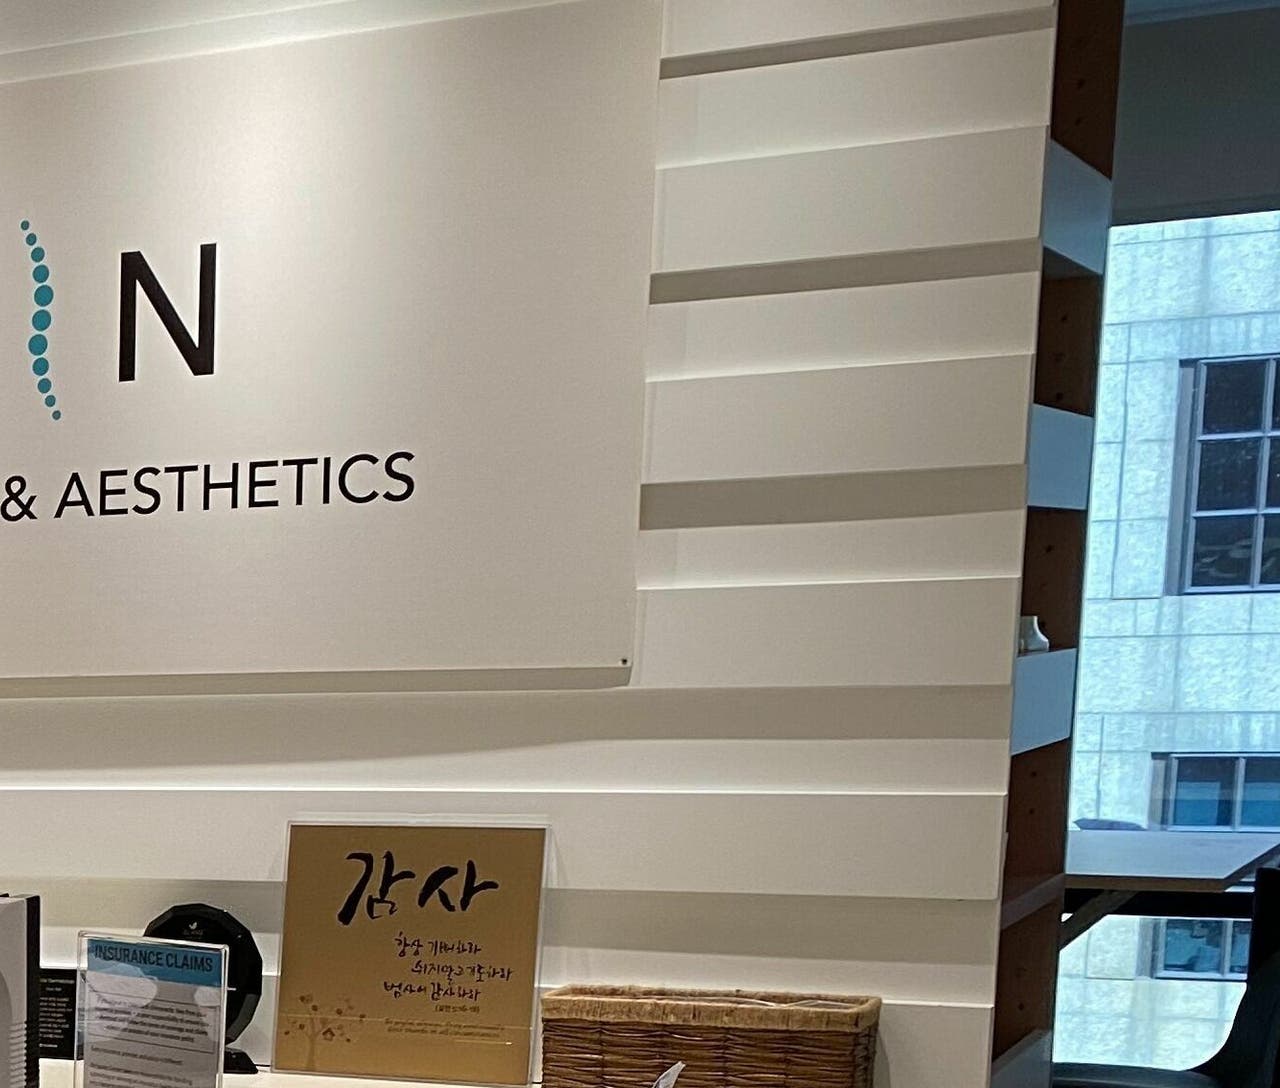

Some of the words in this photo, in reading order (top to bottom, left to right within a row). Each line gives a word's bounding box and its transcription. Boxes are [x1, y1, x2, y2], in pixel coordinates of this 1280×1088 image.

[0, 474, 38, 523] &
[53, 451, 416, 519] AESTHETICS
[336, 850, 500, 926] 감사
[94, 943, 164, 967] INSURANCE
[165, 954, 214, 973] CLAIMS
[394, 930, 424, 958] 항상
[428, 939, 482, 957] 기뻐하라
[383, 980, 427, 999] 범사에
[430, 981, 482, 1002] 감사하라
